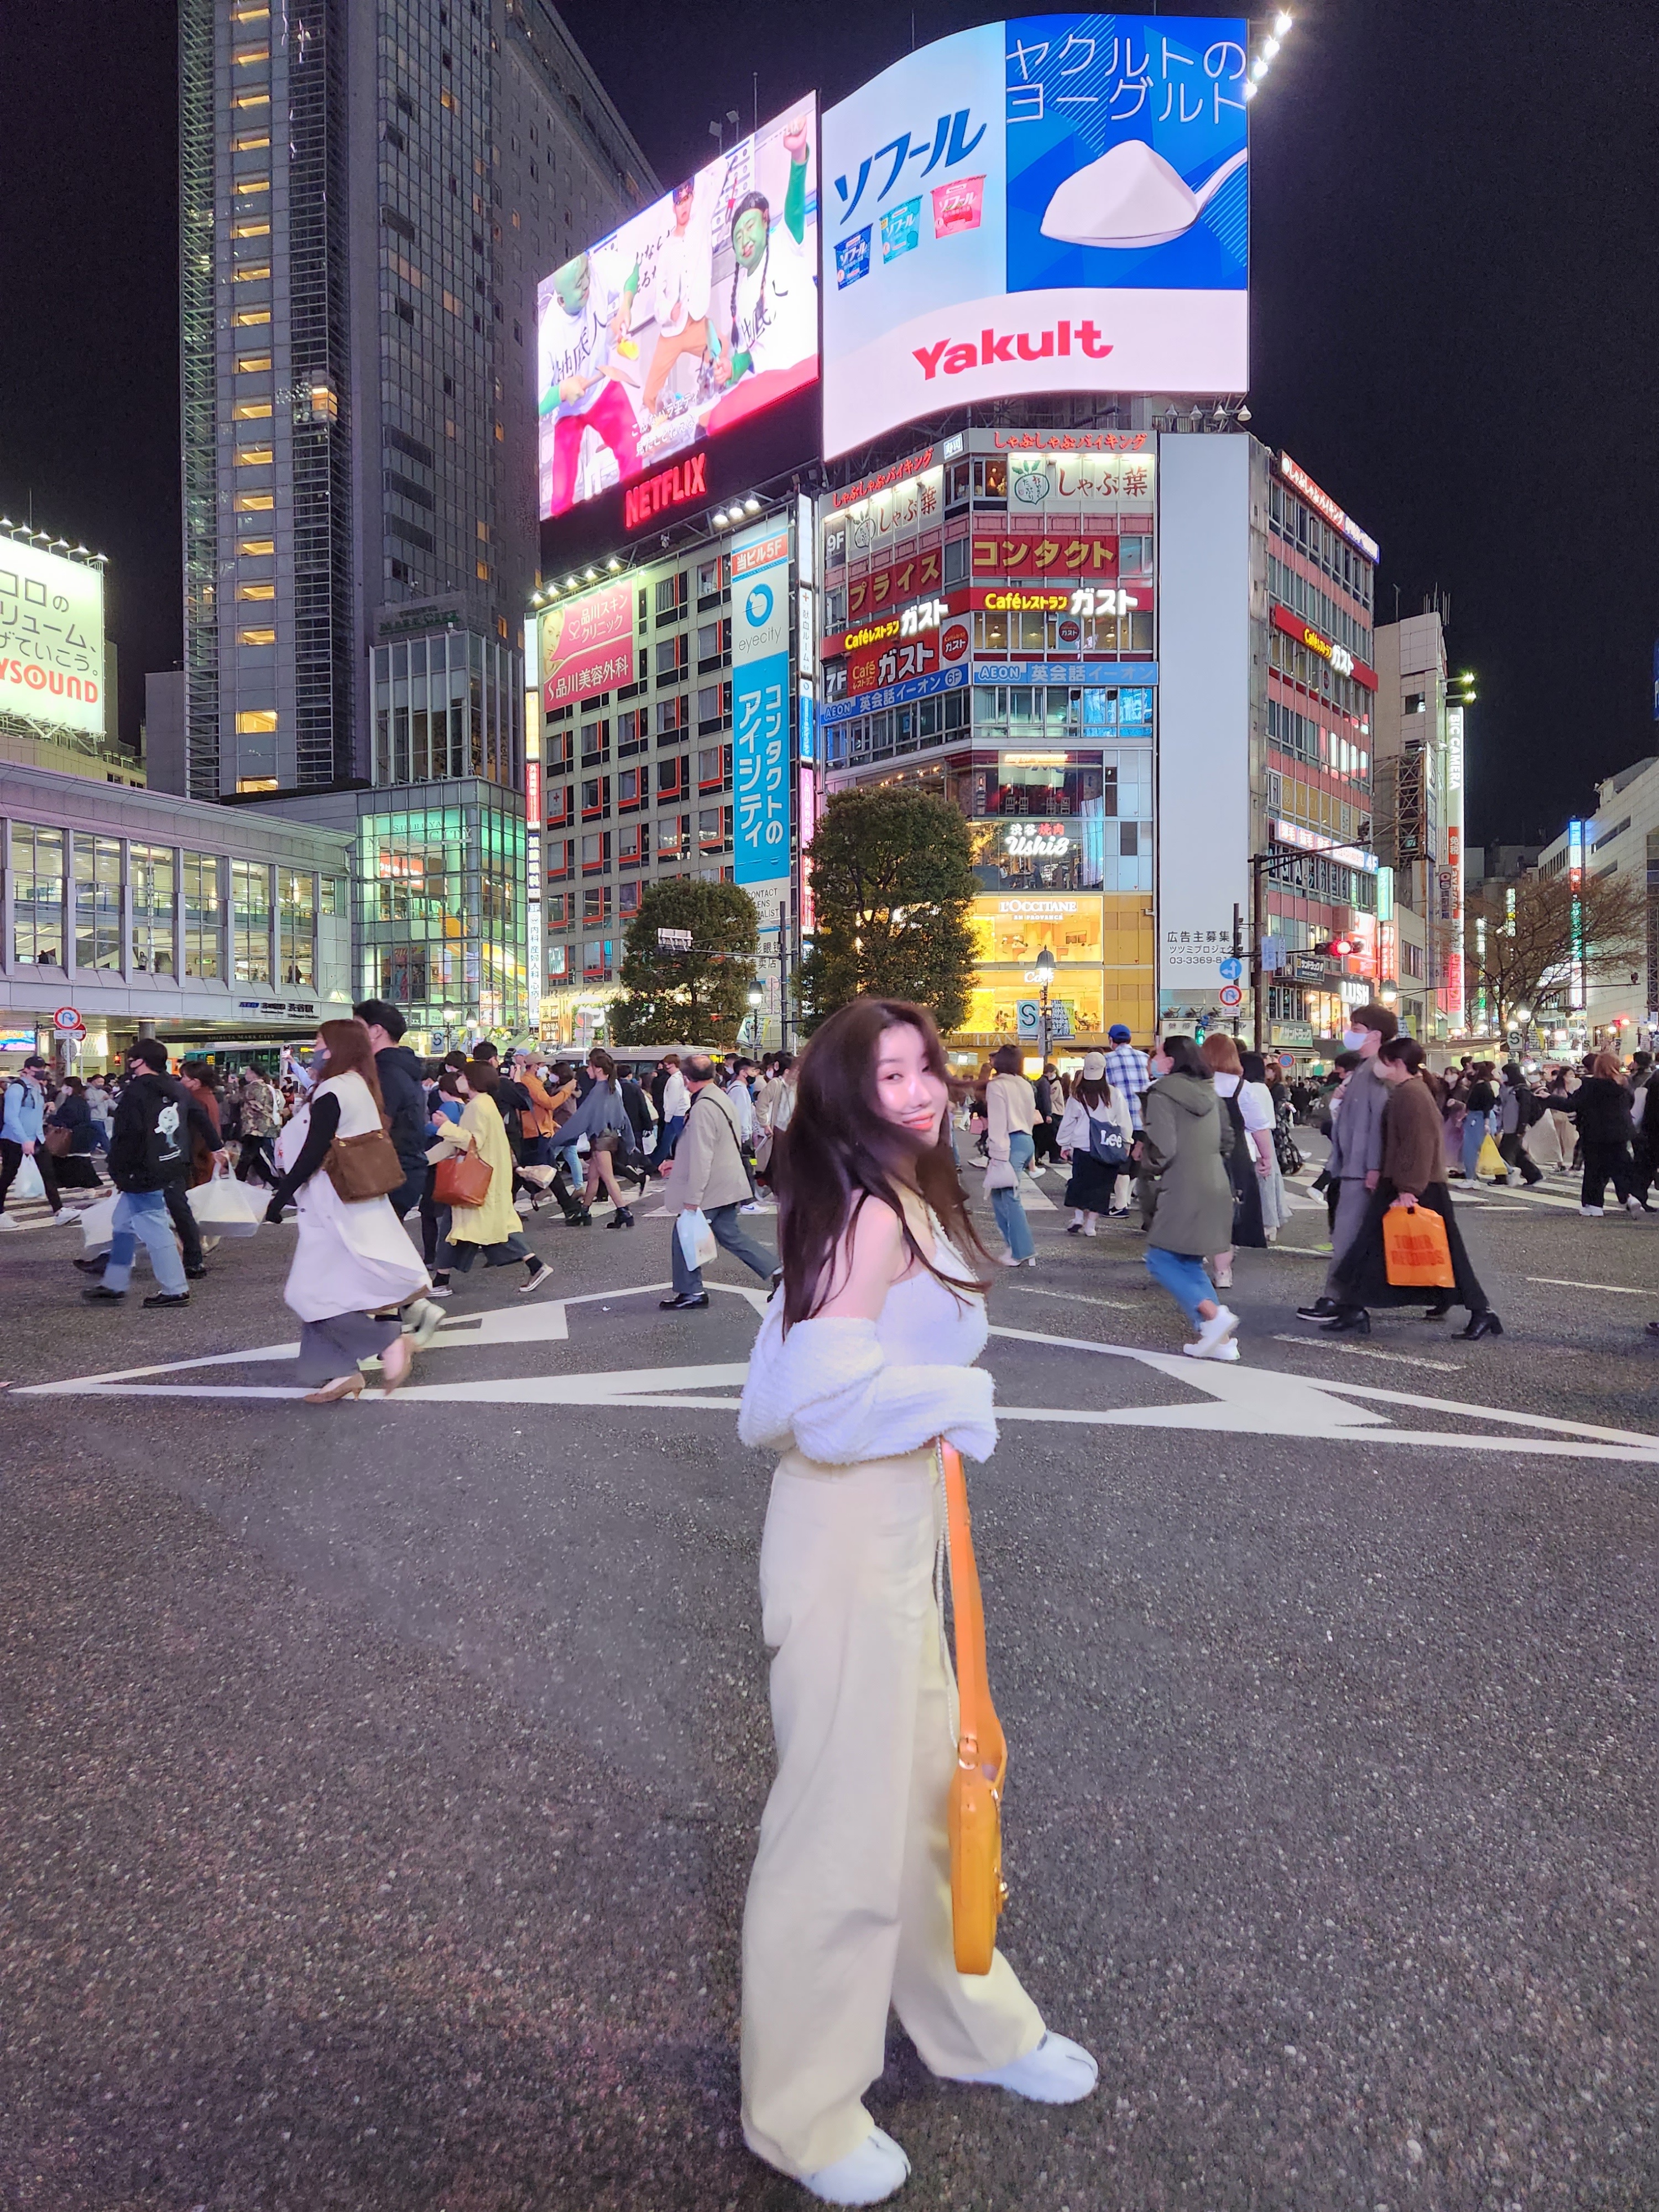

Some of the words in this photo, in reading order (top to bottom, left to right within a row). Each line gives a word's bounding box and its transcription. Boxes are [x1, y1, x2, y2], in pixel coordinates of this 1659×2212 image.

[1006, 33, 1246, 81] ヤクルトの
[1006, 79, 1245, 126] ヨーグルト
[834, 108, 987, 225] ソフール
[912, 319, 1114, 380] Yakult
[994, 431, 1148, 450] しゃぶしゃぶバイキング
[625, 452, 706, 528] NETFLIX
[833, 447, 934, 508] しゃぶしゃぶバイキング
[1058, 466, 1148, 497] しゃぶ葉
[880, 486, 937, 532] しゃぶ葉
[737, 538, 782, 572] 当ビル5F
[827, 530, 845, 552] 9F
[974, 539, 1114, 568] コンタクト
[850, 554, 940, 611] プライス
[581, 594, 628, 625] 品川スキン
[901, 598, 948, 636] ガスト
[985, 593, 1067, 609] Caféレストラン
[1071, 588, 1138, 616] ガスト
[582, 614, 623, 643] クリニック
[738, 626, 782, 654] eyecity
[945, 638, 966, 653] ガスト
[1330, 644, 1354, 677] ガスト
[556, 655, 629, 699] 品川美容外科
[852, 661, 876, 680] Café
[878, 641, 935, 686] ガスト
[980, 666, 1020, 680] AEON
[1031, 665, 1154, 682] 英会話イーオン
[825, 702, 852, 719] AEON
[859, 676, 941, 713] 英会話イーオン
[947, 671, 961, 685] 6F
[826, 670, 847, 693] 7F
[853, 677, 875, 690] レストラン
[1449, 714, 1460, 734] BIC
[739, 690, 763, 848] アイシティ
[765, 684, 783, 844] コンタクトの
[1449, 738, 1460, 790] CAMERA
[429, 828, 472, 841] CITY
[1004, 835, 1070, 856] Ushi8
[1365, 854, 1378, 873] 4F
[1000, 899, 1077, 912] L'OCCITANE
[1167, 931, 1230, 943] 広告主募集
[1169, 945, 1234, 954] ツツミプロジェク
[1342, 981, 1370, 1006] LUSH
[1100, 1129, 1123, 1149] Lee
